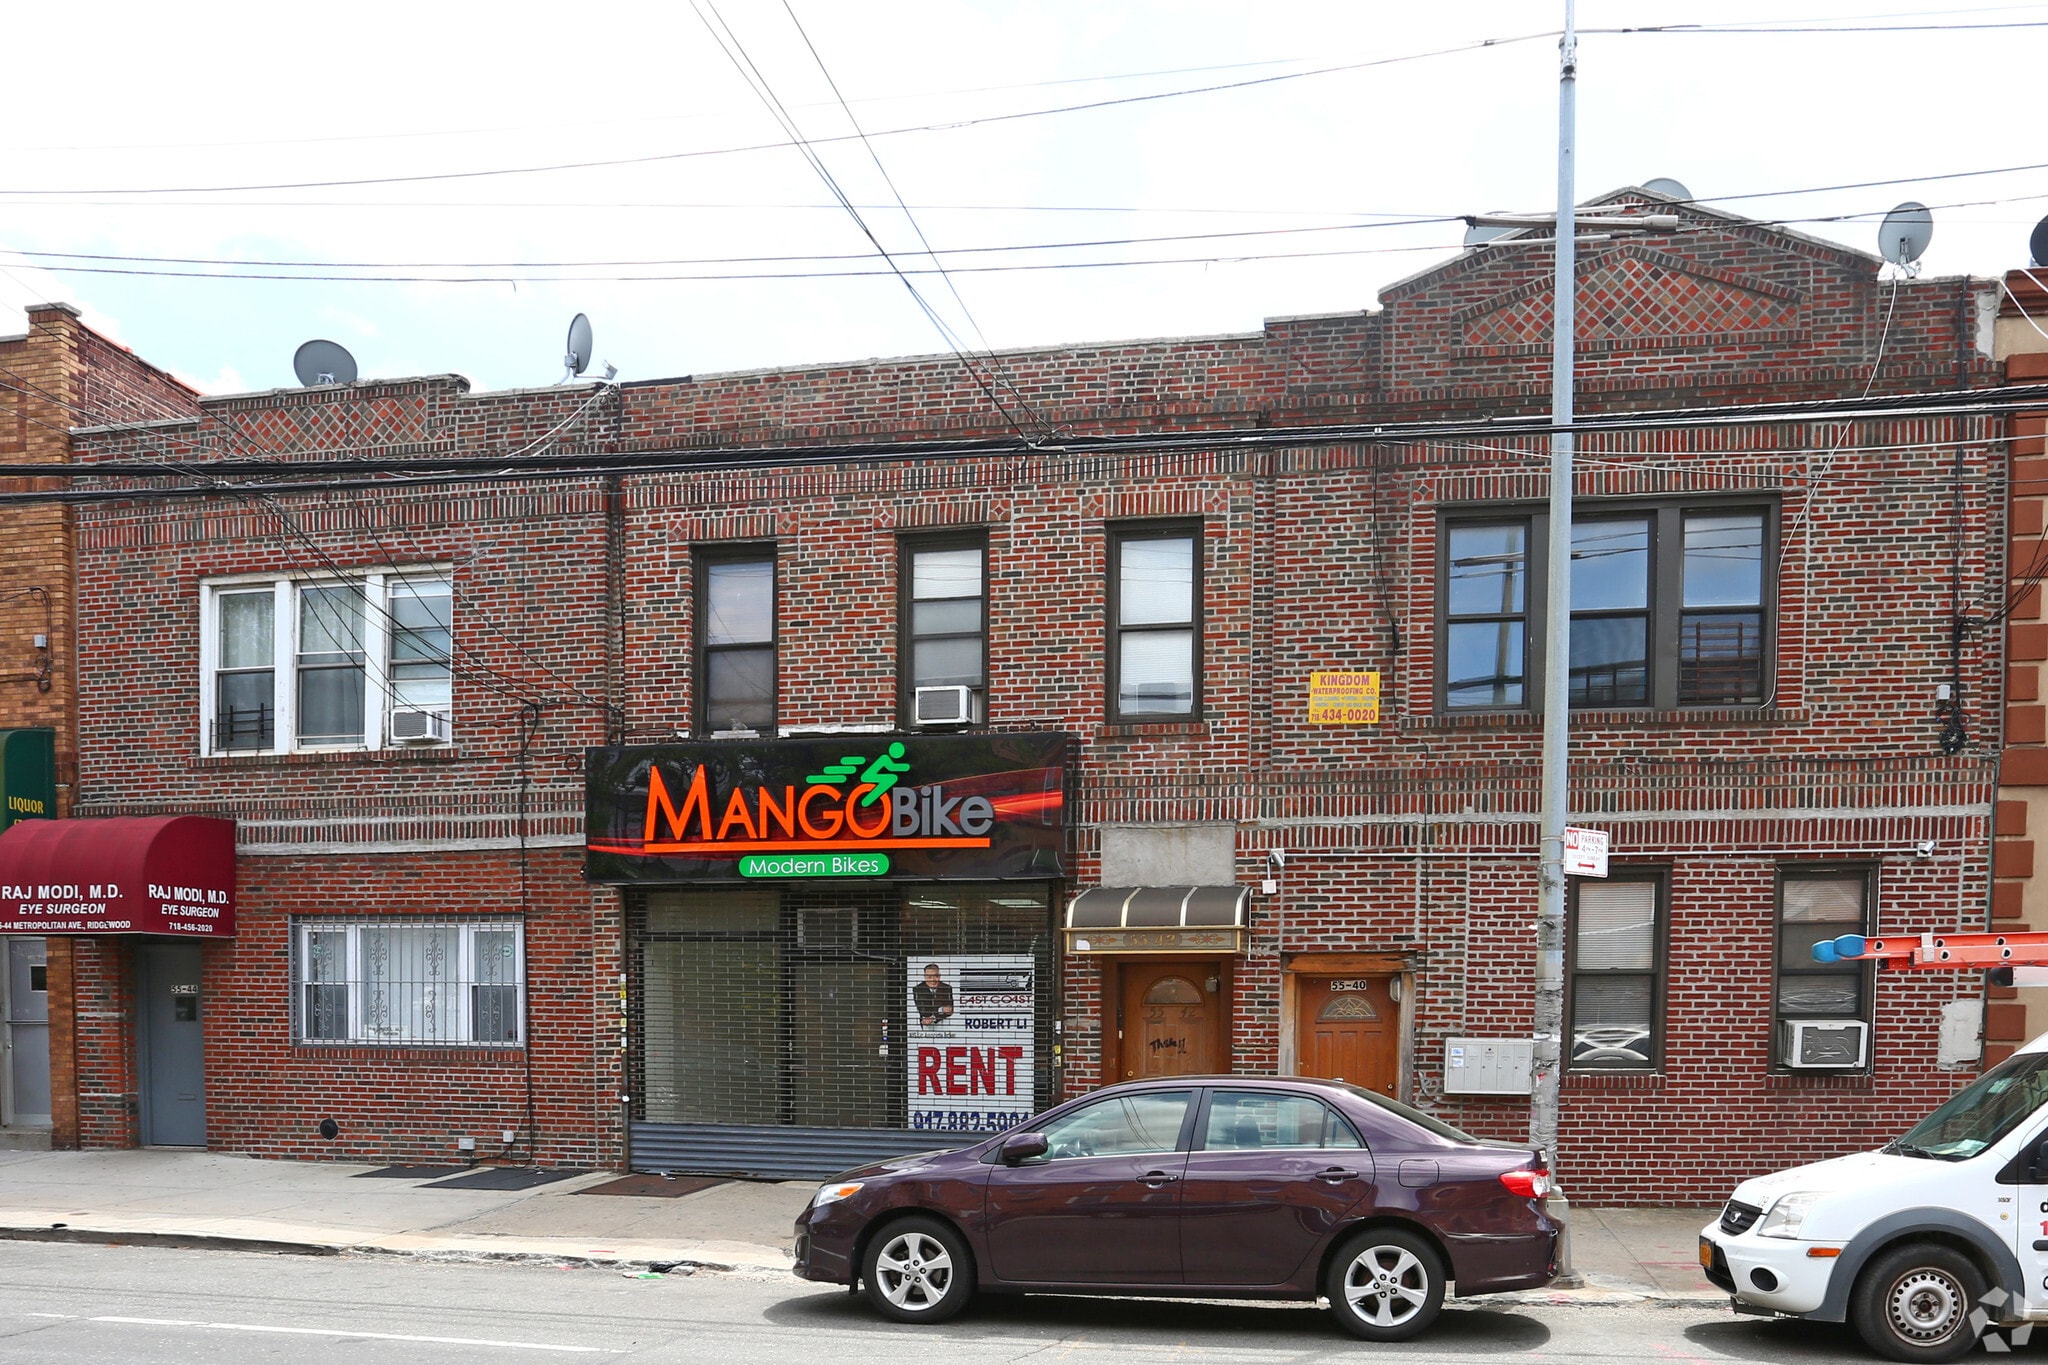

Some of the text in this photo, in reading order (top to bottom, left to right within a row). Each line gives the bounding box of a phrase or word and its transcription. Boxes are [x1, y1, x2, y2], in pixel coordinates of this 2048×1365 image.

[1320, 675, 1370, 686] KINGDOM
[1313, 687, 1377, 695] WATERPROOFING CO.
[1322, 708, 1376, 721] 434-0020
[8, 796, 44, 814] LIQUOR
[1566, 832, 1604, 846] NO PARKING
[749, 856, 879, 875] Modern Bikes
[1, 884, 124, 901] RAJ MODI, M.D.
[148, 884, 230, 905] RAJ MODI, M.D.
[19, 903, 106, 915] EYE SURGEON
[161, 904, 220, 918] EYE SURGEON
[13, 921, 67, 930] METROPOLITAN
[168, 922, 213, 932] 718-456-2020
[171, 985, 198, 993] 55-44
[1331, 980, 1366, 990] 55-40
[960, 995, 988, 1004] EAST
[965, 1018, 1027, 1030] ROBERT LI
[917, 1046, 1023, 1096] RENT
